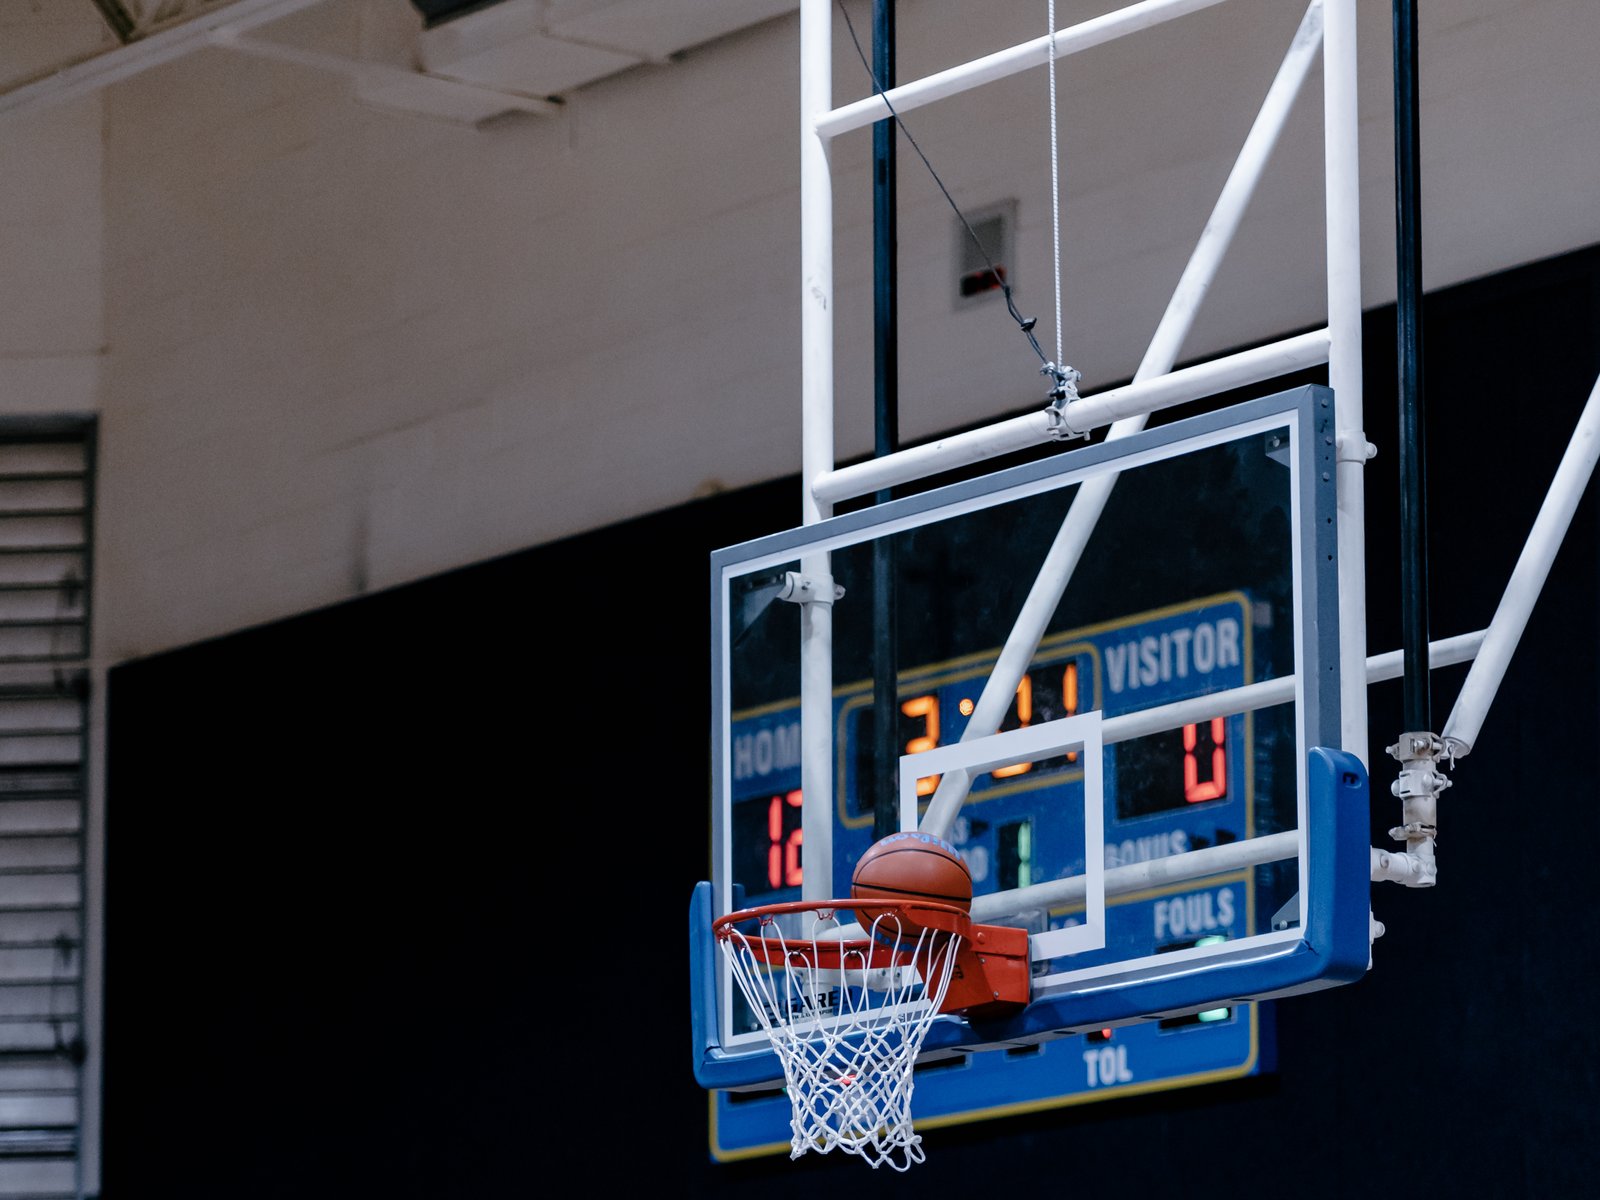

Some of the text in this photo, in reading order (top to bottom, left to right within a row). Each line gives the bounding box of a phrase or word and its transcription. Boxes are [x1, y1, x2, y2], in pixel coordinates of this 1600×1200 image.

[1104, 617, 1240, 693] VISITOR
[734, 722, 802, 780] HOM
[1154, 888, 1236, 940] FOULS
[1083, 1044, 1133, 1087] TOL
